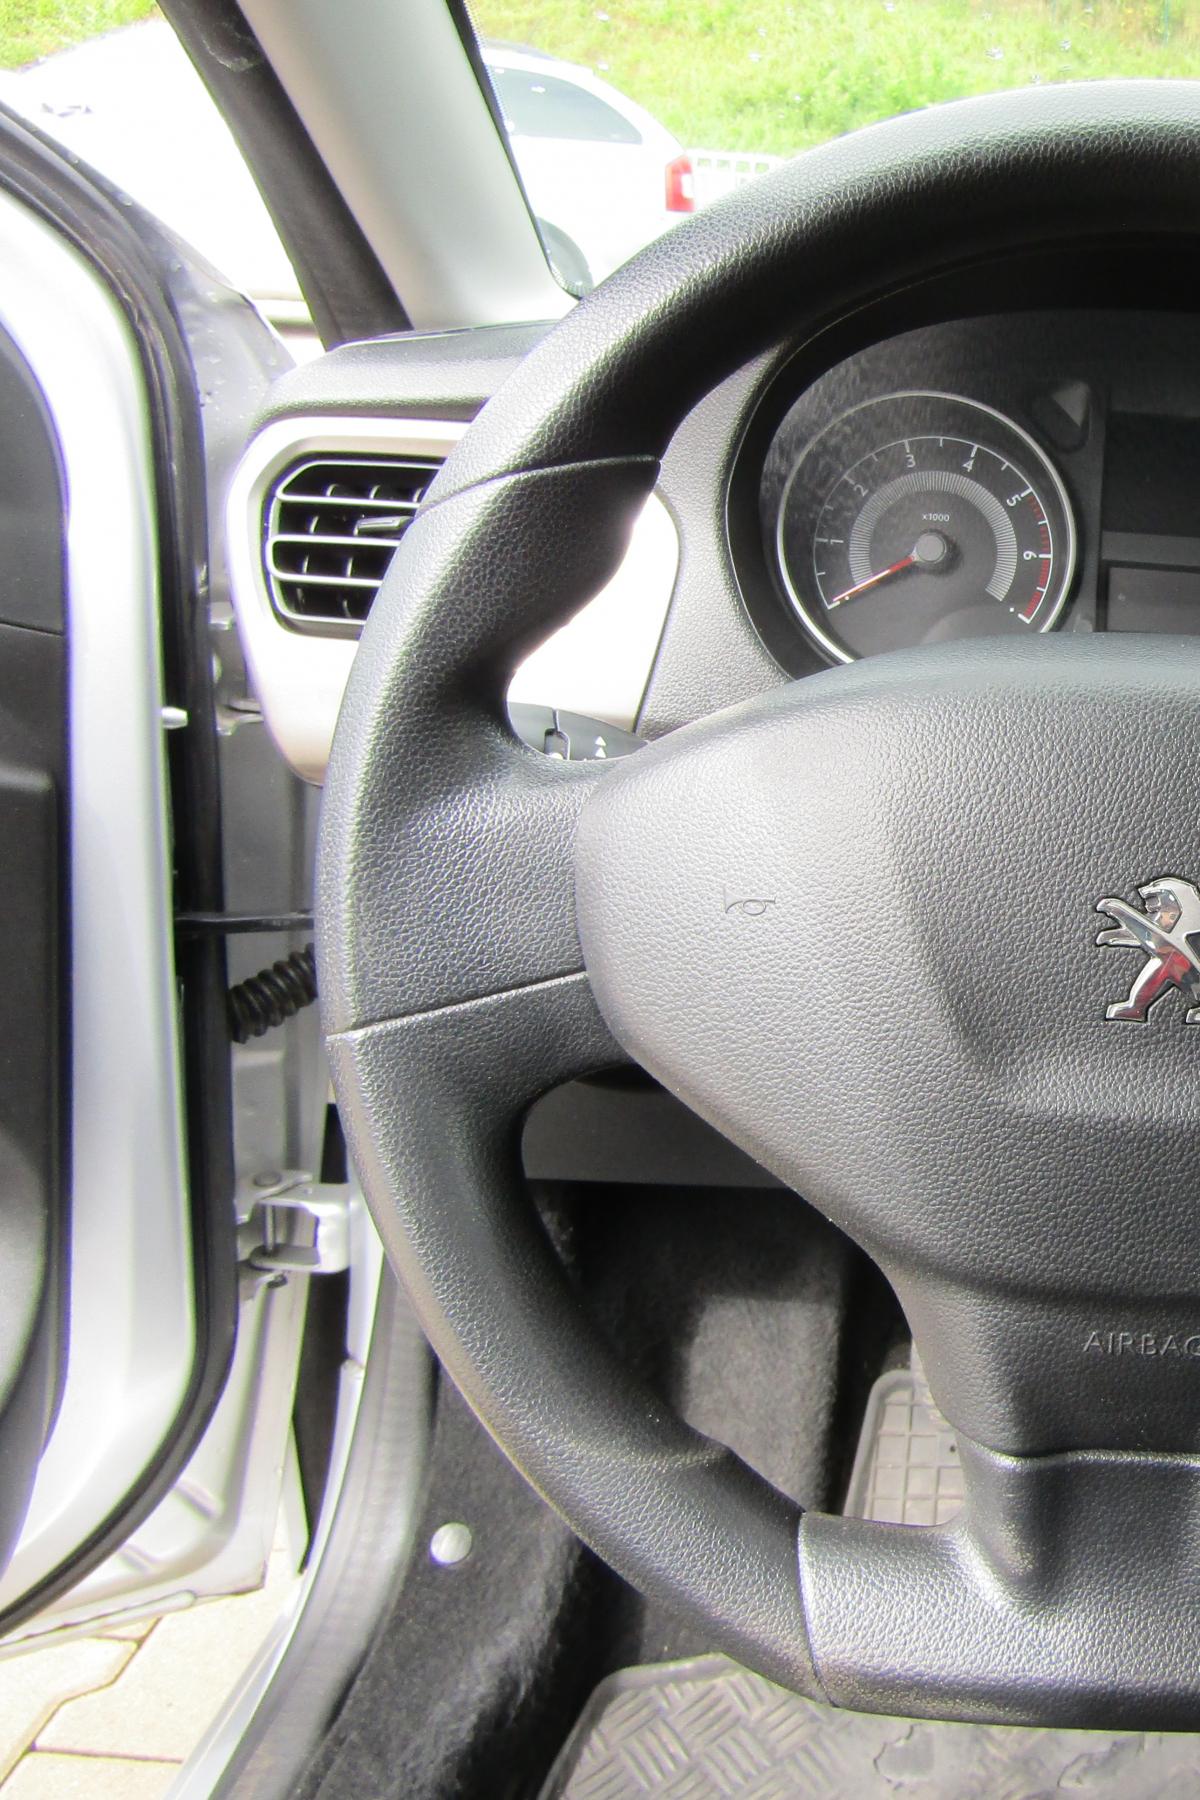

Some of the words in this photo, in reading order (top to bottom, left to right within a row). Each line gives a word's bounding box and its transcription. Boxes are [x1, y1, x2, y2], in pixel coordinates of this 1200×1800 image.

[904, 453, 917, 469] 3
[962, 458, 975, 473] 4
[853, 483, 870, 497] 2
[1005, 493, 1022, 508] 5
[829, 537, 845, 546] 1
[1022, 550, 1038, 562] 6
